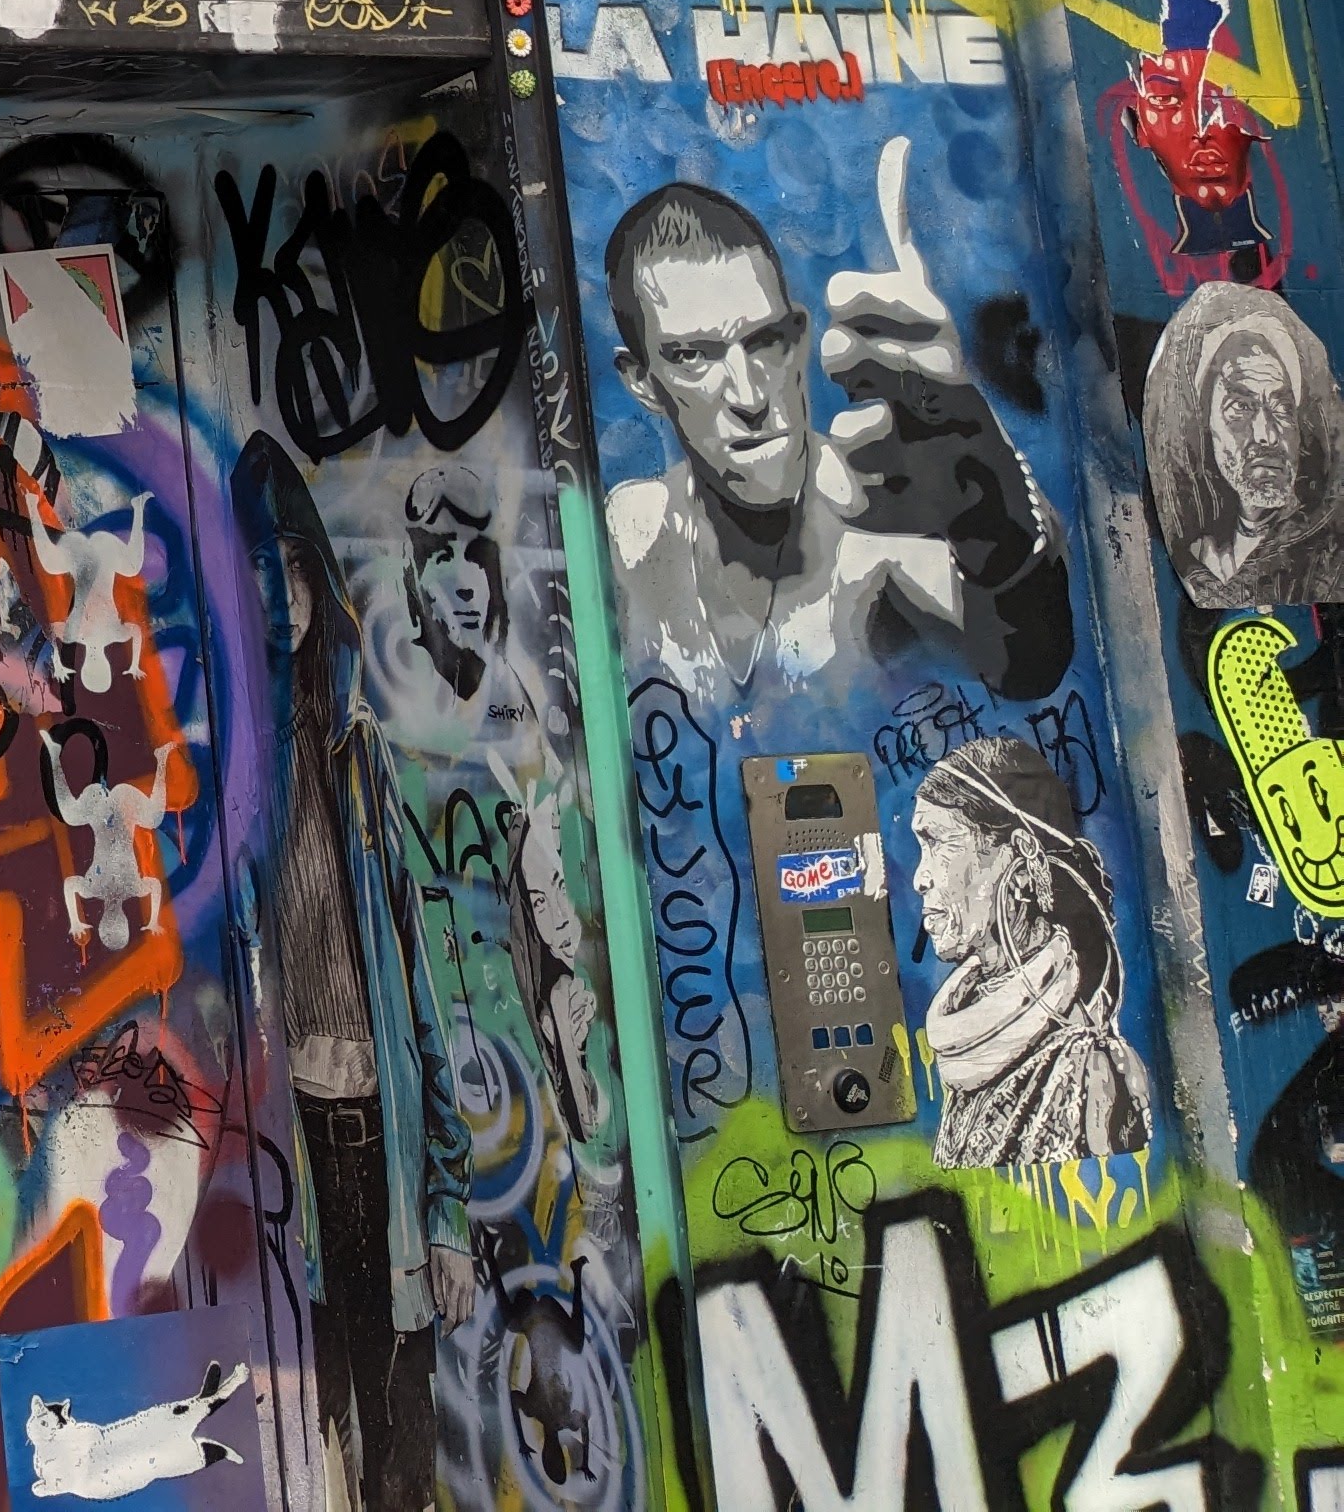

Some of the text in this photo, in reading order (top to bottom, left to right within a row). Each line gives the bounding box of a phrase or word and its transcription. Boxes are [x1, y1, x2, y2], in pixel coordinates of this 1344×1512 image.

[546, 3, 673, 81] LA
[692, 6, 1007, 87] HAINE
[1311, 1301, 1341, 1314] NOTRE
